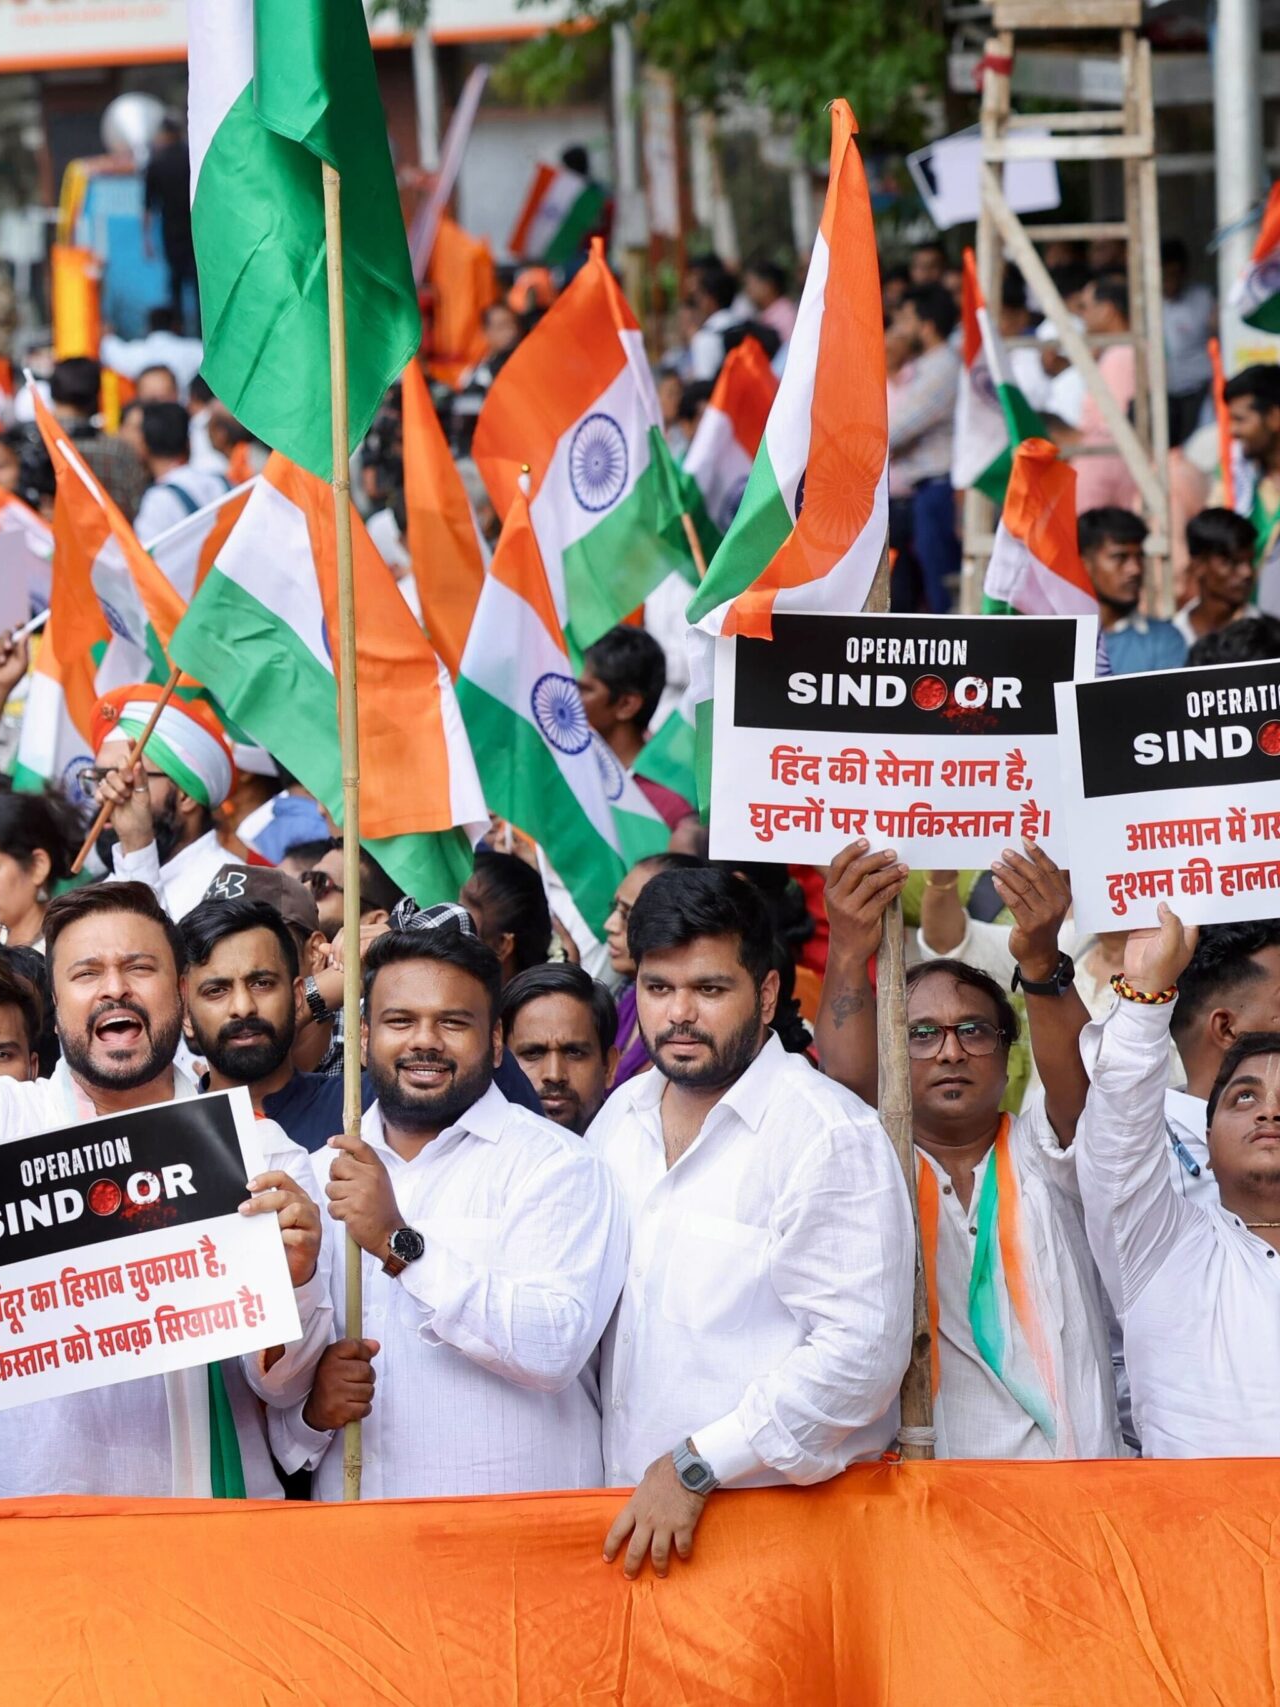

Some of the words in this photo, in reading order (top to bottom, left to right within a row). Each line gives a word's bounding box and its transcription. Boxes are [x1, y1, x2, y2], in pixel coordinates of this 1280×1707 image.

[845, 637, 968, 666] OPERATION
[1186, 684, 1280, 718] OPERATI
[770, 745, 822, 786] हिंद
[827, 748, 870, 785] की
[875, 750, 934, 788] सेना
[940, 758, 1000, 788] शान
[1006, 748, 1033, 792] है,
[749, 796, 825, 842] घुटनों
[830, 807, 869, 836] पर
[874, 802, 1015, 838] पाकिस्तान
[1125, 817, 1221, 852] आसमान
[1226, 807, 1246, 843] में
[1106, 868, 1174, 916] दुश्मन
[1179, 857, 1213, 896] की
[20, 1136, 133, 1187] OPERATION
[27, 1280, 58, 1313] का
[60, 1266, 125, 1307] हिसाब
[125, 1249, 200, 1302] चुकाया
[197, 1234, 227, 1279] है,
[61, 1324, 94, 1365] को
[94, 1318, 153, 1356] सबक़
[154, 1298, 239, 1345] सिखाया
[237, 1284, 267, 1326] है!
